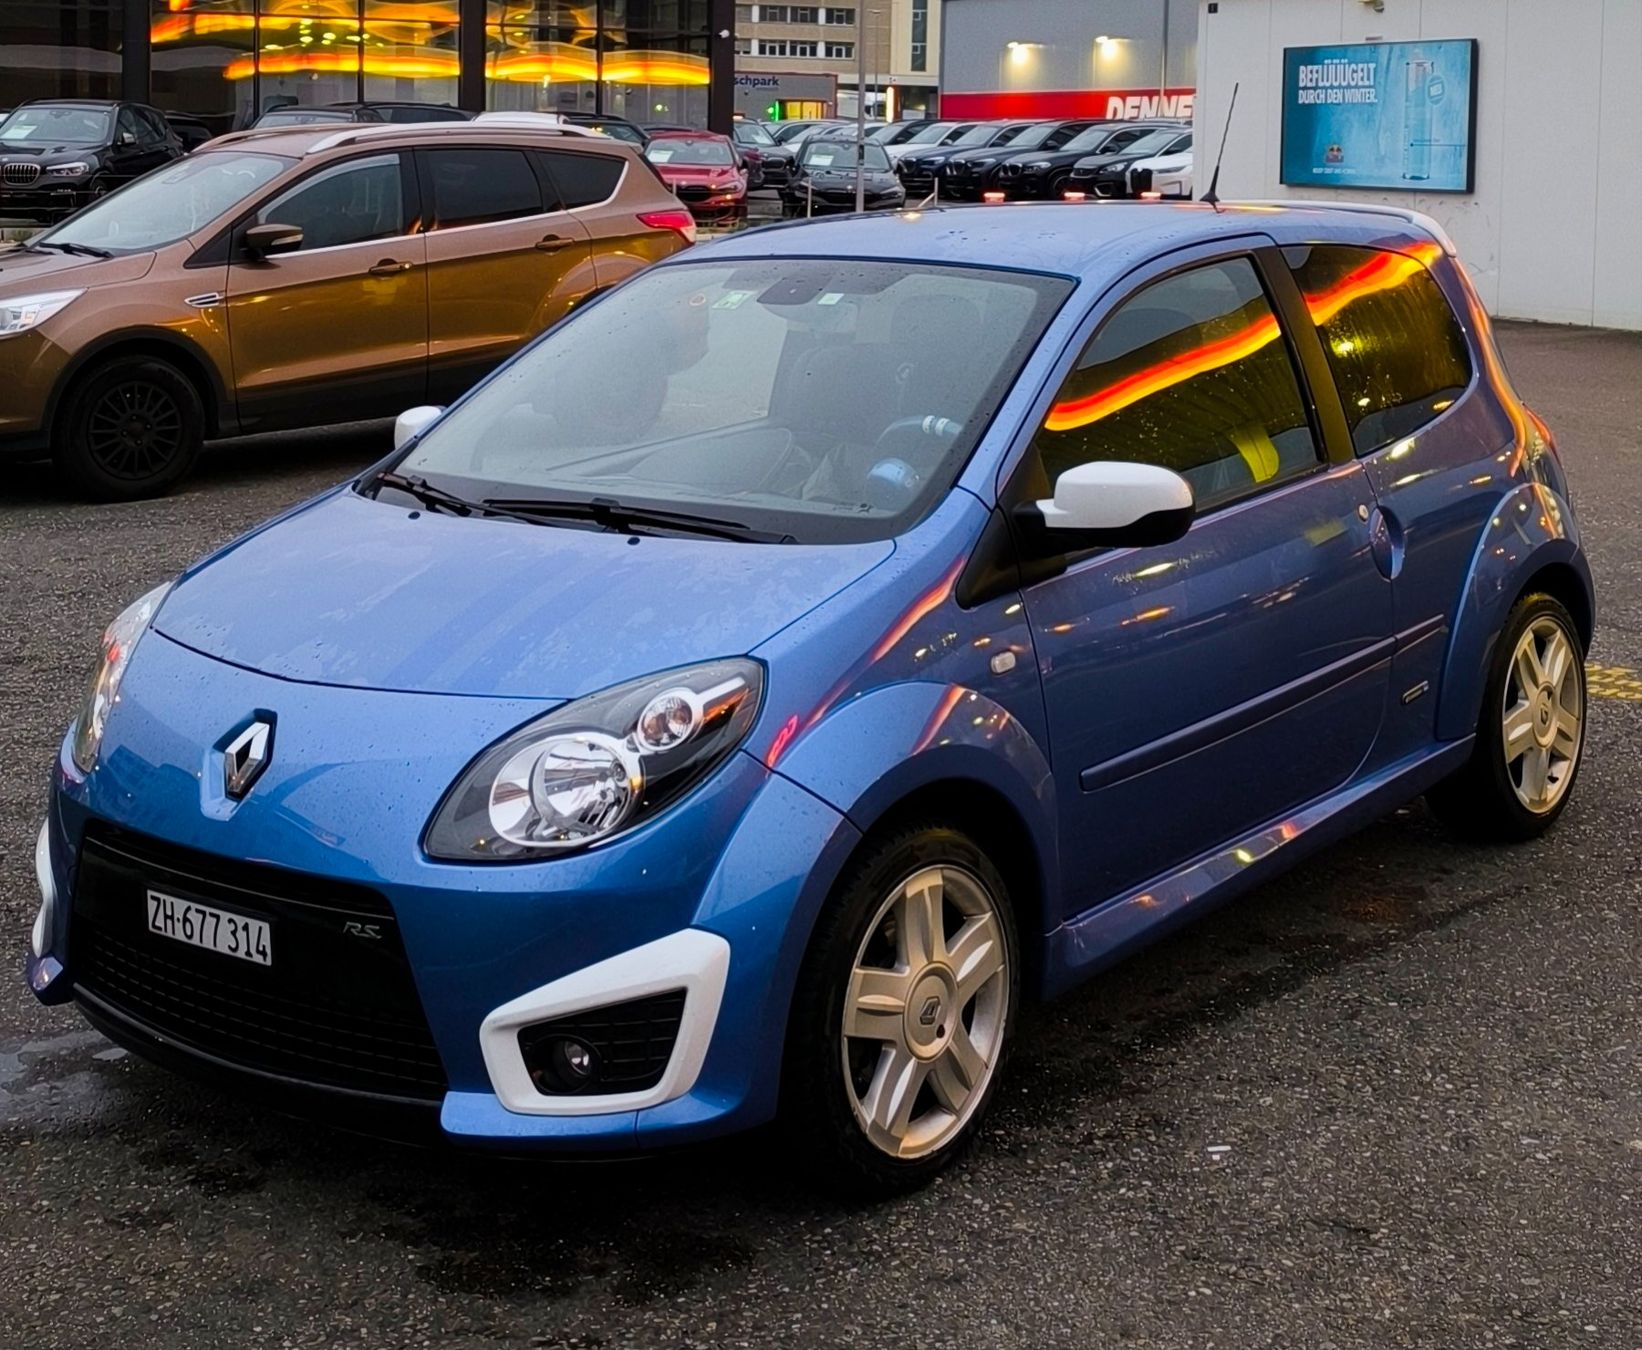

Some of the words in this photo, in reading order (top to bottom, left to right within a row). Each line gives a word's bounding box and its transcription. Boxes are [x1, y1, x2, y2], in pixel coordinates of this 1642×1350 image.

[1299, 58, 1376, 87] BEFLÜÜÜGELT
[1298, 89, 1325, 104] DURCH
[1327, 89, 1343, 103] DEN
[1344, 88, 1378, 103] WINTER.
[342, 921, 382, 939] RS
